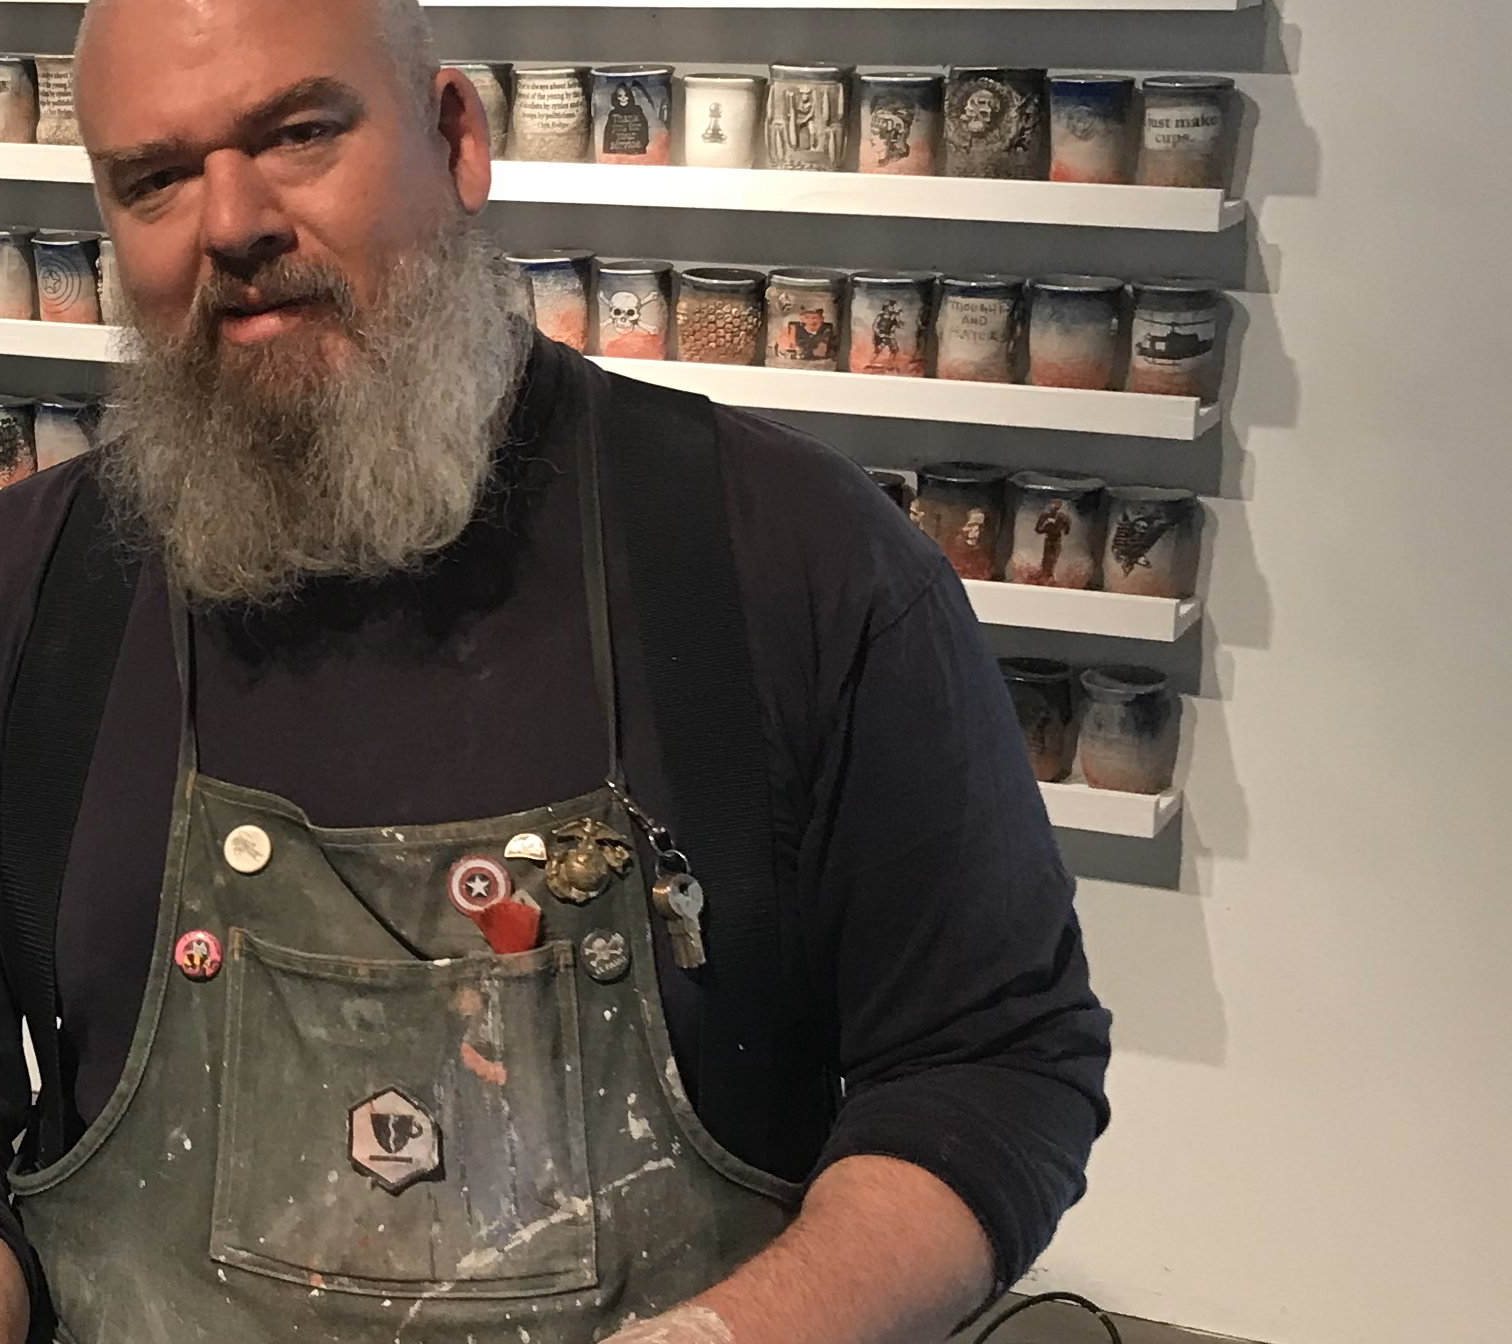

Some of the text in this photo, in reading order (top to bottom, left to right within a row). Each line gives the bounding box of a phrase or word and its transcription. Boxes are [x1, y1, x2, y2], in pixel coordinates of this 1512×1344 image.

[1175, 114, 1218, 128] make
[1155, 133, 1195, 148] cups.
[962, 315, 988, 326] AND
